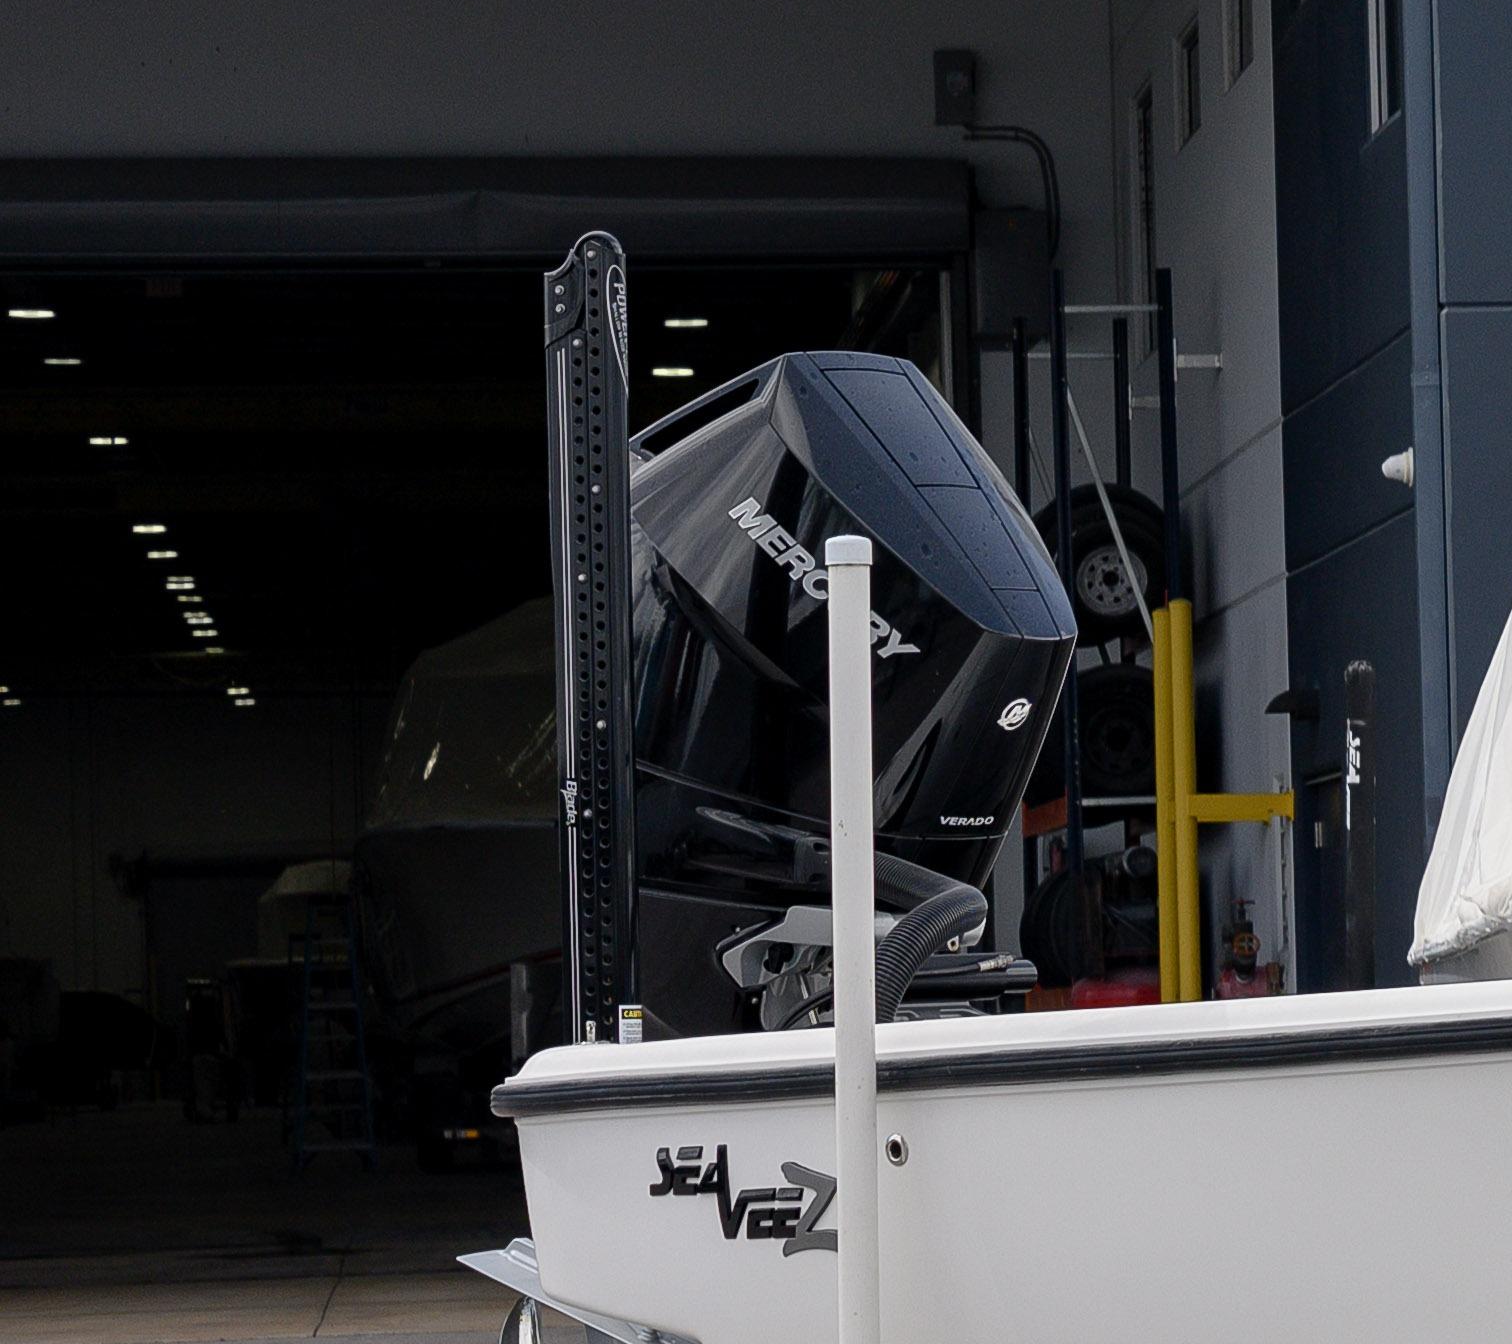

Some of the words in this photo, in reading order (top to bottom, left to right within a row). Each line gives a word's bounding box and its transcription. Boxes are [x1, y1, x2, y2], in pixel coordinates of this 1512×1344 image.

[728, 496, 921, 659] MERCRY
[940, 815, 995, 826] VERADO
[649, 1143, 728, 1197] SEA
